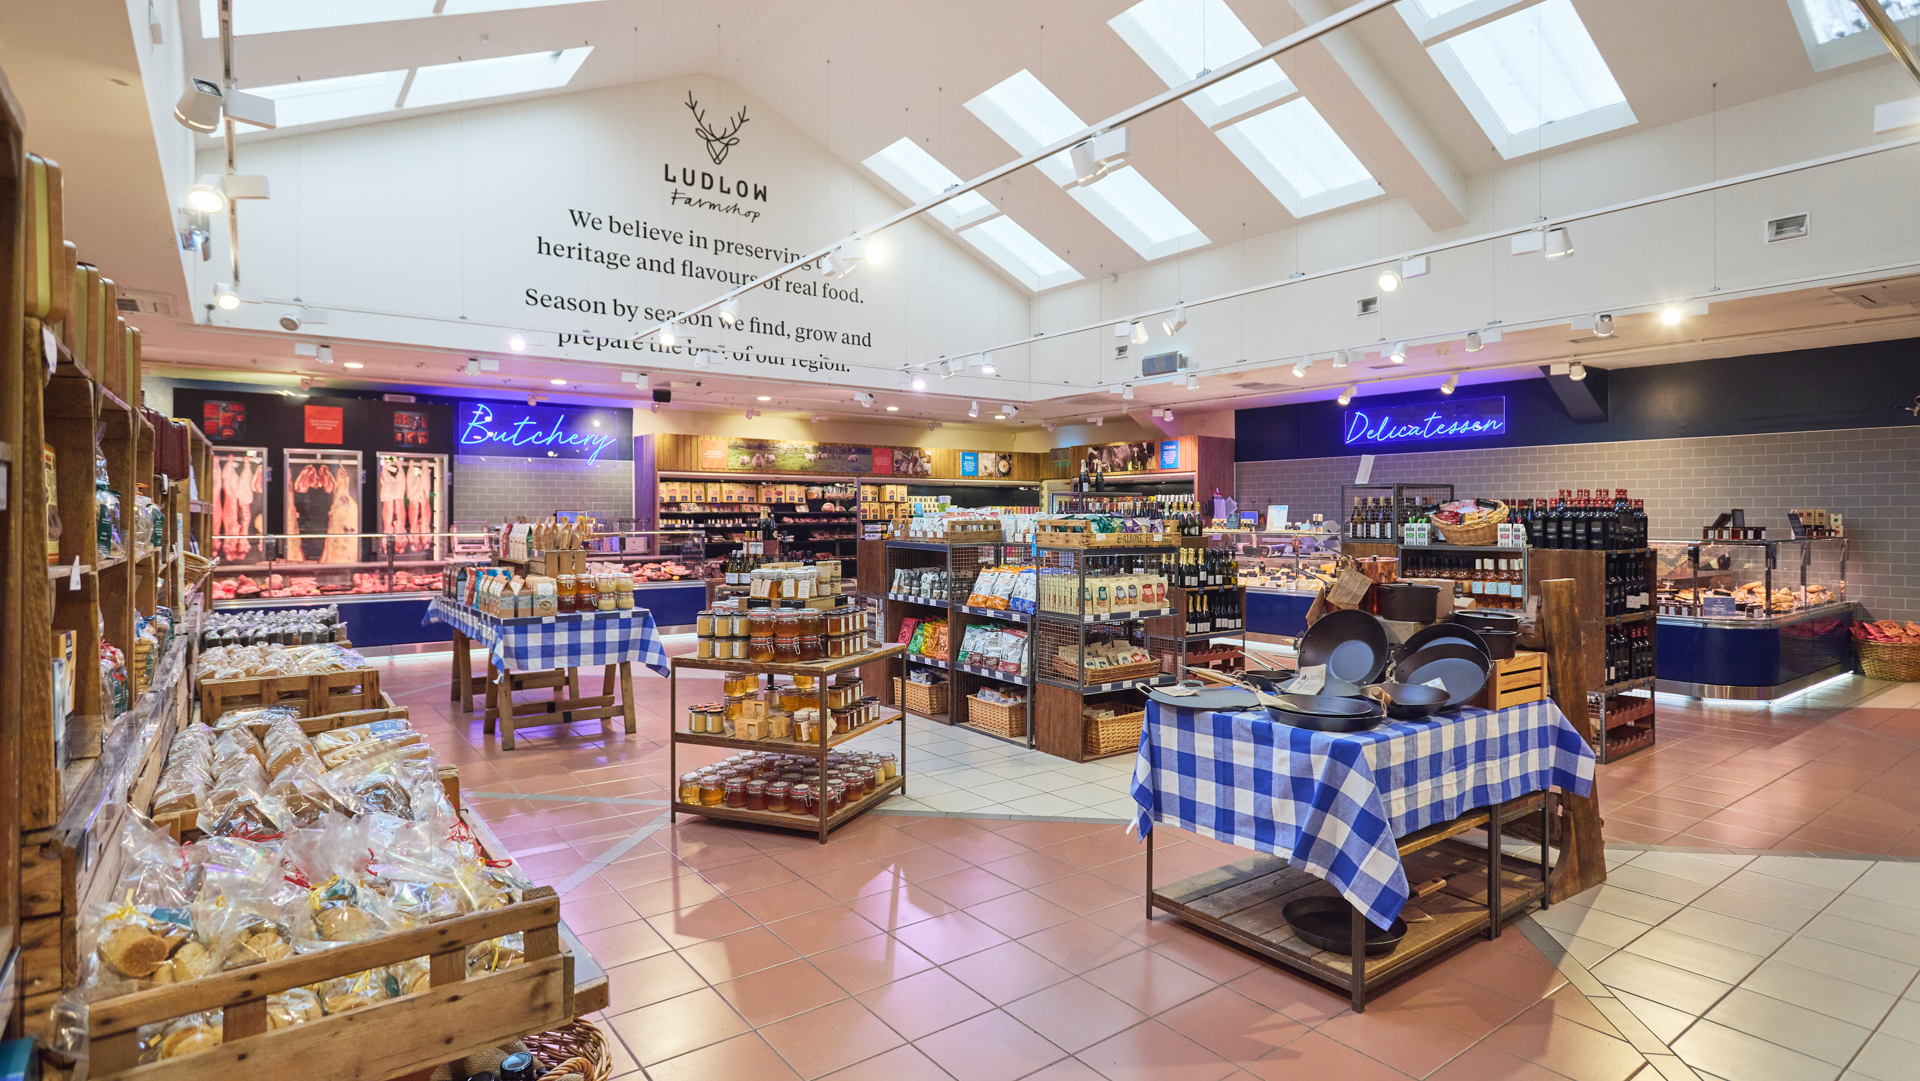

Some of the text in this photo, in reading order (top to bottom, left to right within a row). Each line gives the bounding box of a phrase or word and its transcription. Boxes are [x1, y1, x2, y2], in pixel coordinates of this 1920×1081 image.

[664, 163, 767, 202] LUDLOW
[670, 188, 761, 223] Farmshop
[568, 208, 603, 231] We
[608, 215, 683, 245] believe
[689, 230, 708, 250] in
[536, 235, 631, 270] heritage
[636, 253, 676, 275] and
[785, 280, 818, 298] real
[822, 282, 865, 305] food.
[525, 288, 607, 315] Season
[613, 298, 639, 323] by
[718, 316, 745, 332] we
[749, 316, 791, 340] find,
[795, 326, 838, 343] grow
[841, 331, 872, 348] and
[461, 404, 616, 465] Butchery
[1346, 411, 1503, 444] Delicatessen
